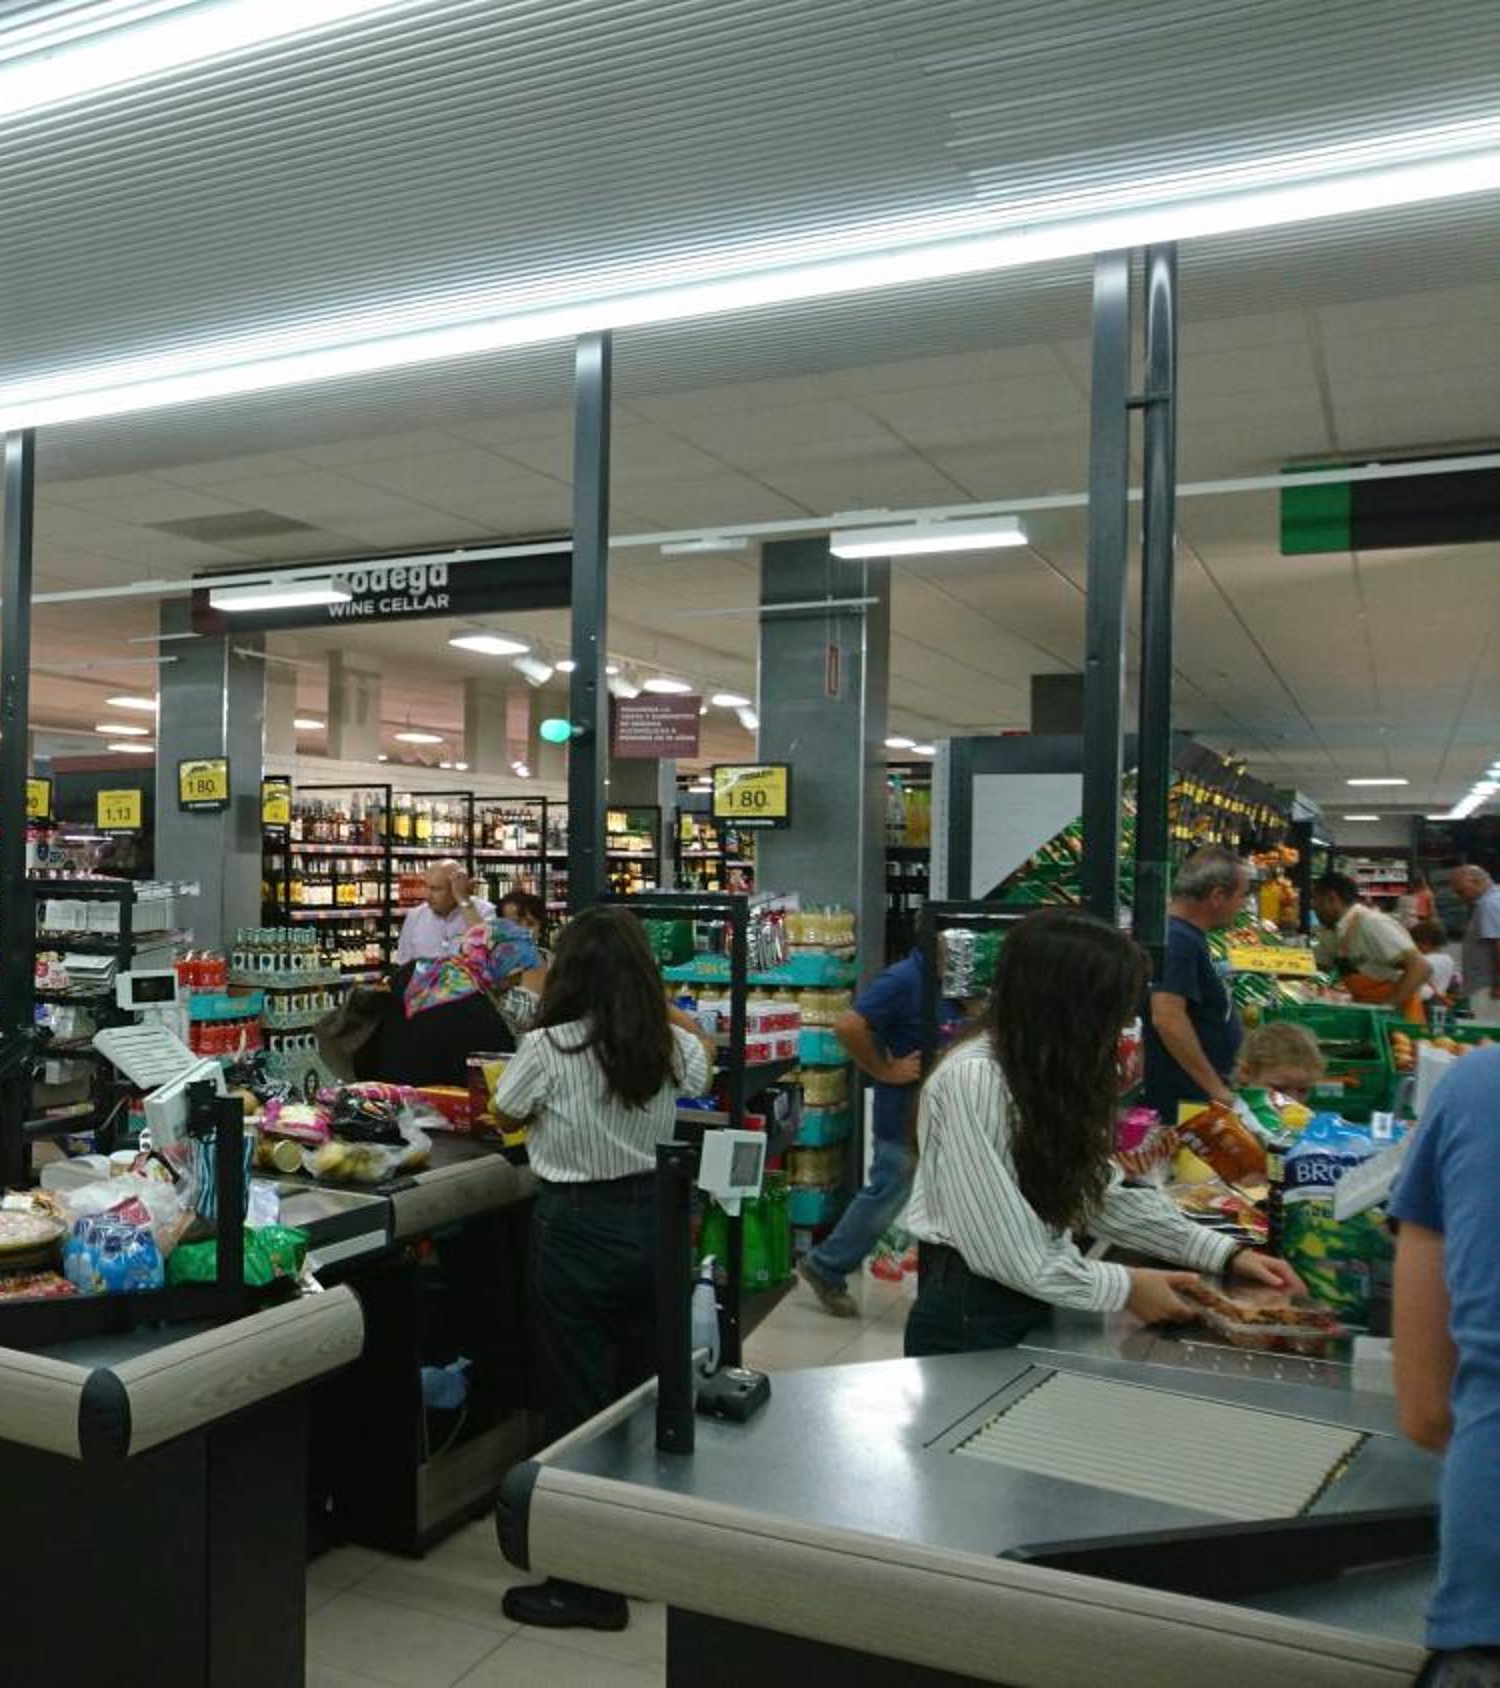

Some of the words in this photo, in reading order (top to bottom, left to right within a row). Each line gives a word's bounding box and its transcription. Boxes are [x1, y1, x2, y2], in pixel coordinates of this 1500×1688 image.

[328, 599, 375, 618] WINE
[379, 593, 449, 613] CELLAR
[1296, 1161, 1349, 1184] BRO
